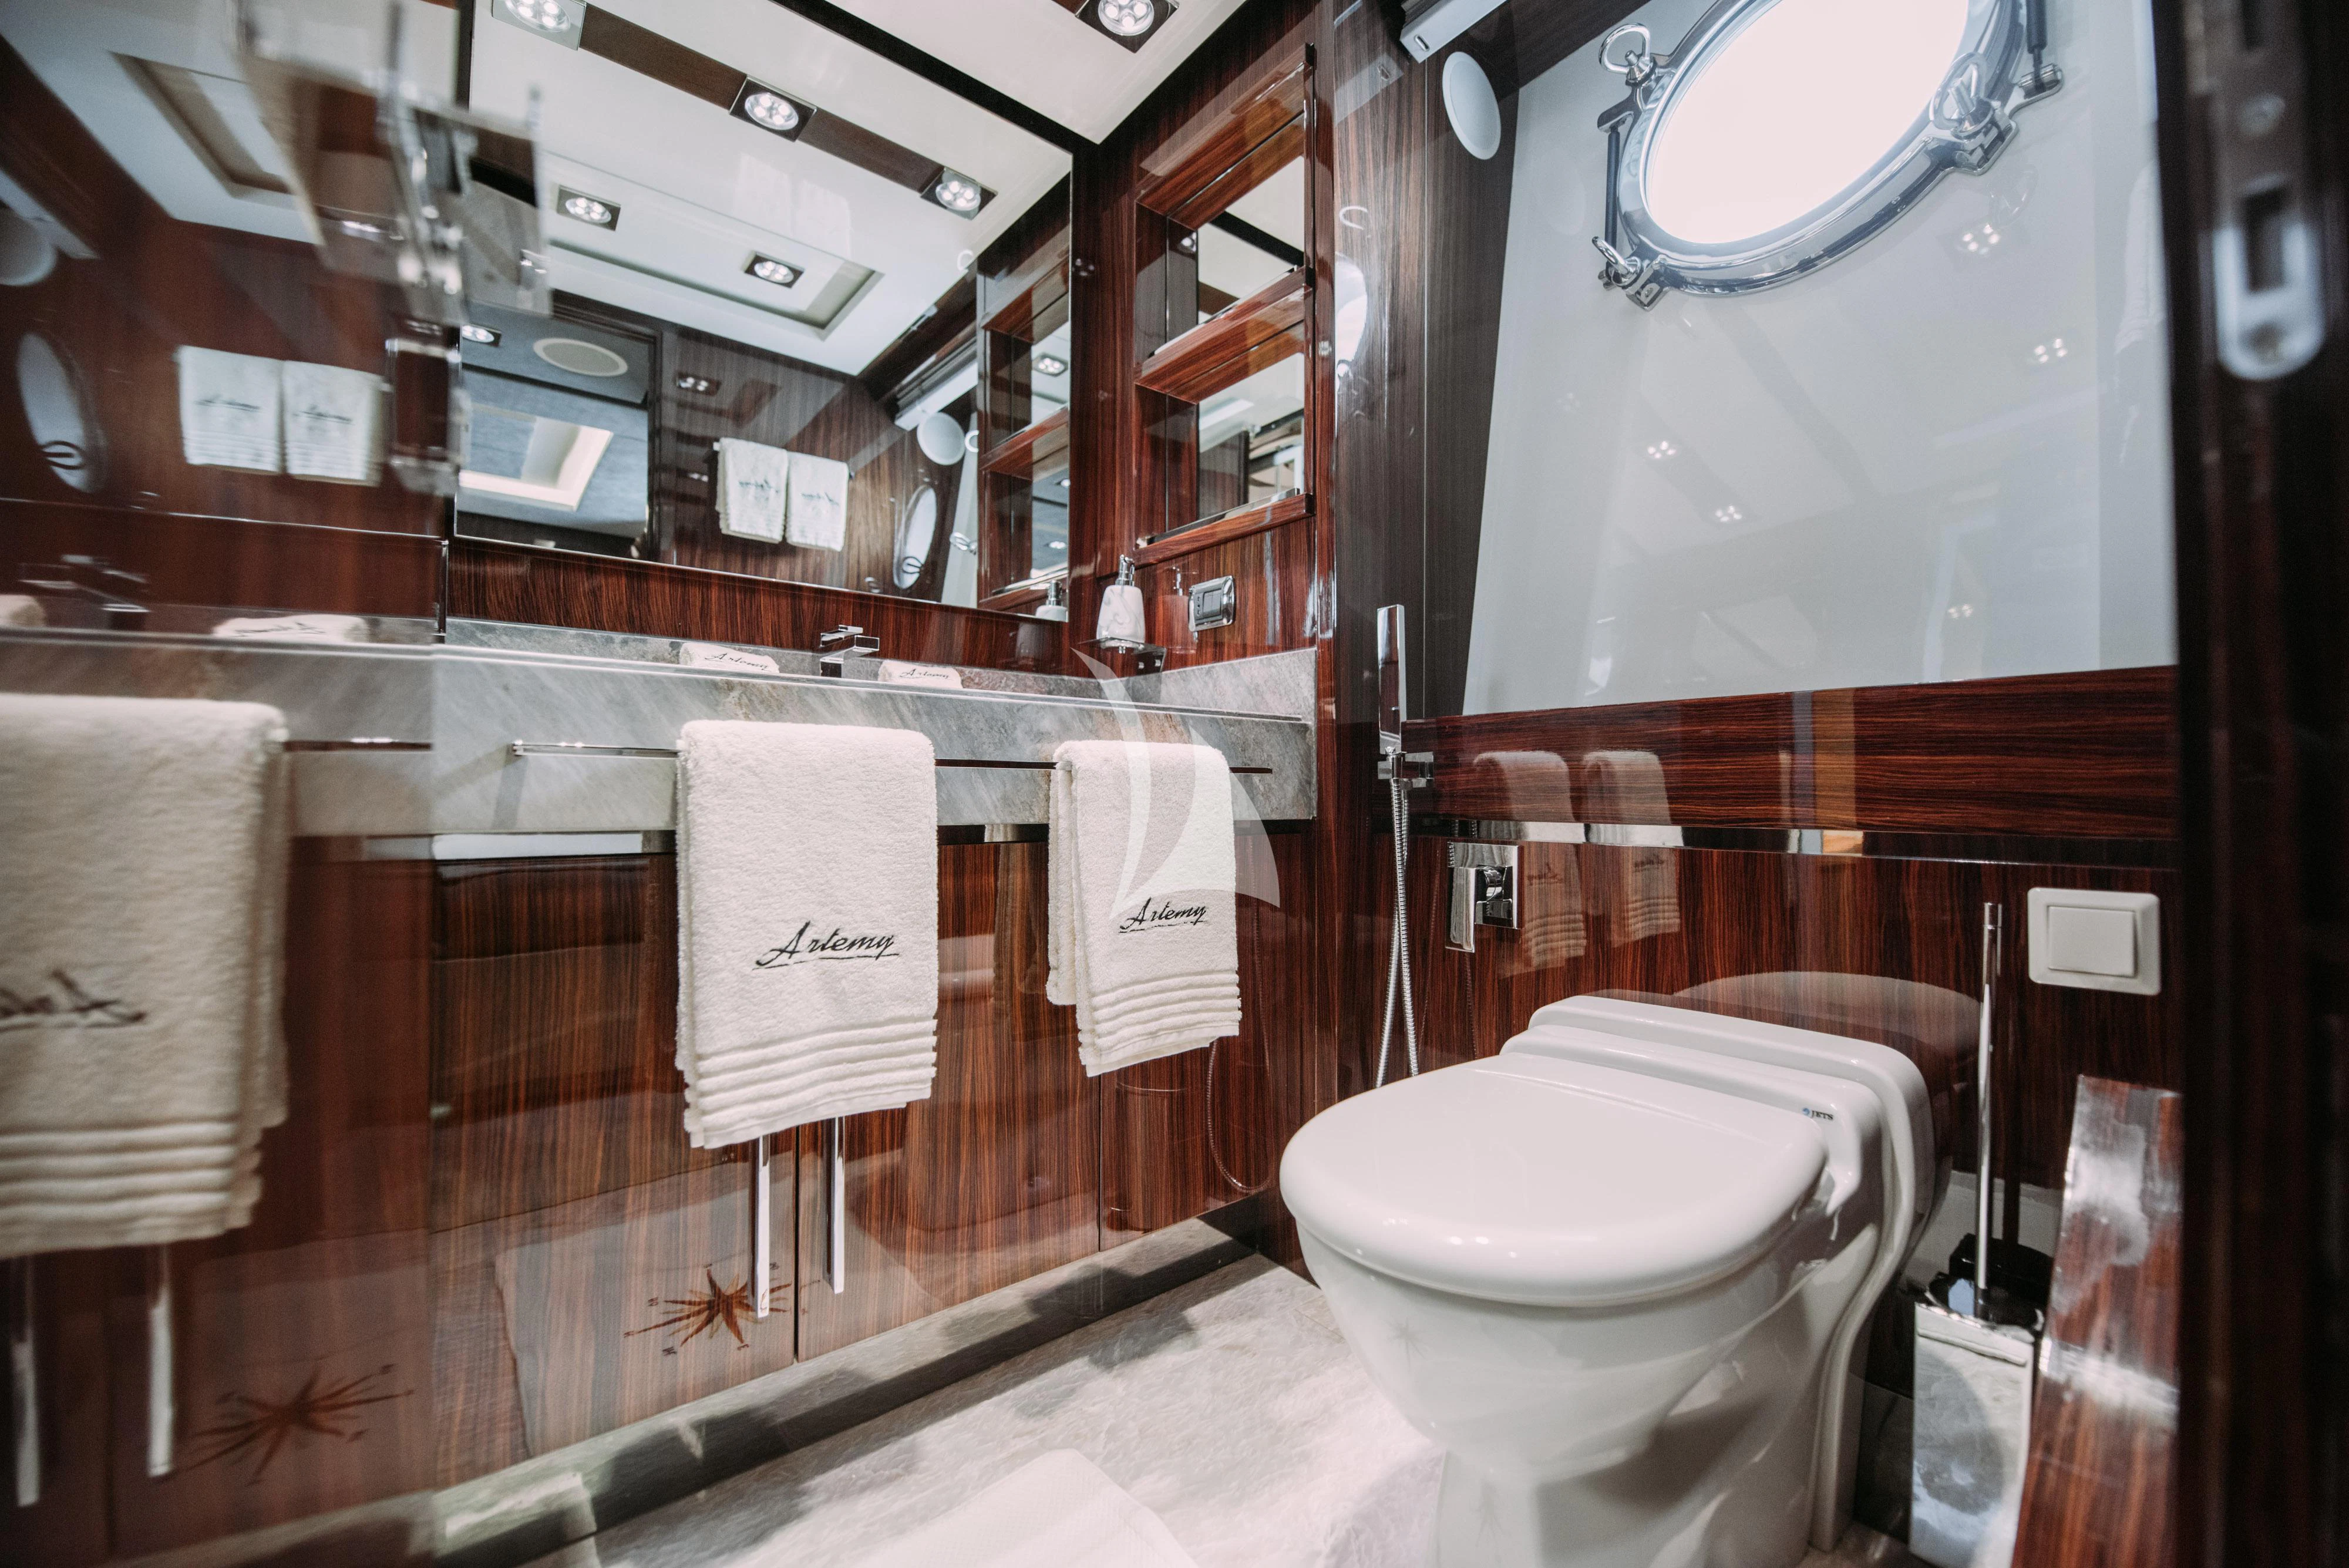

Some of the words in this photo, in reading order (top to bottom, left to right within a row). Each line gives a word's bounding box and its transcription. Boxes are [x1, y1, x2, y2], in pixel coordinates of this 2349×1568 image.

[1120, 897, 1207, 931] Artemy
[754, 920, 896, 968] Artemy
[1812, 1110, 1834, 1121] JETS
